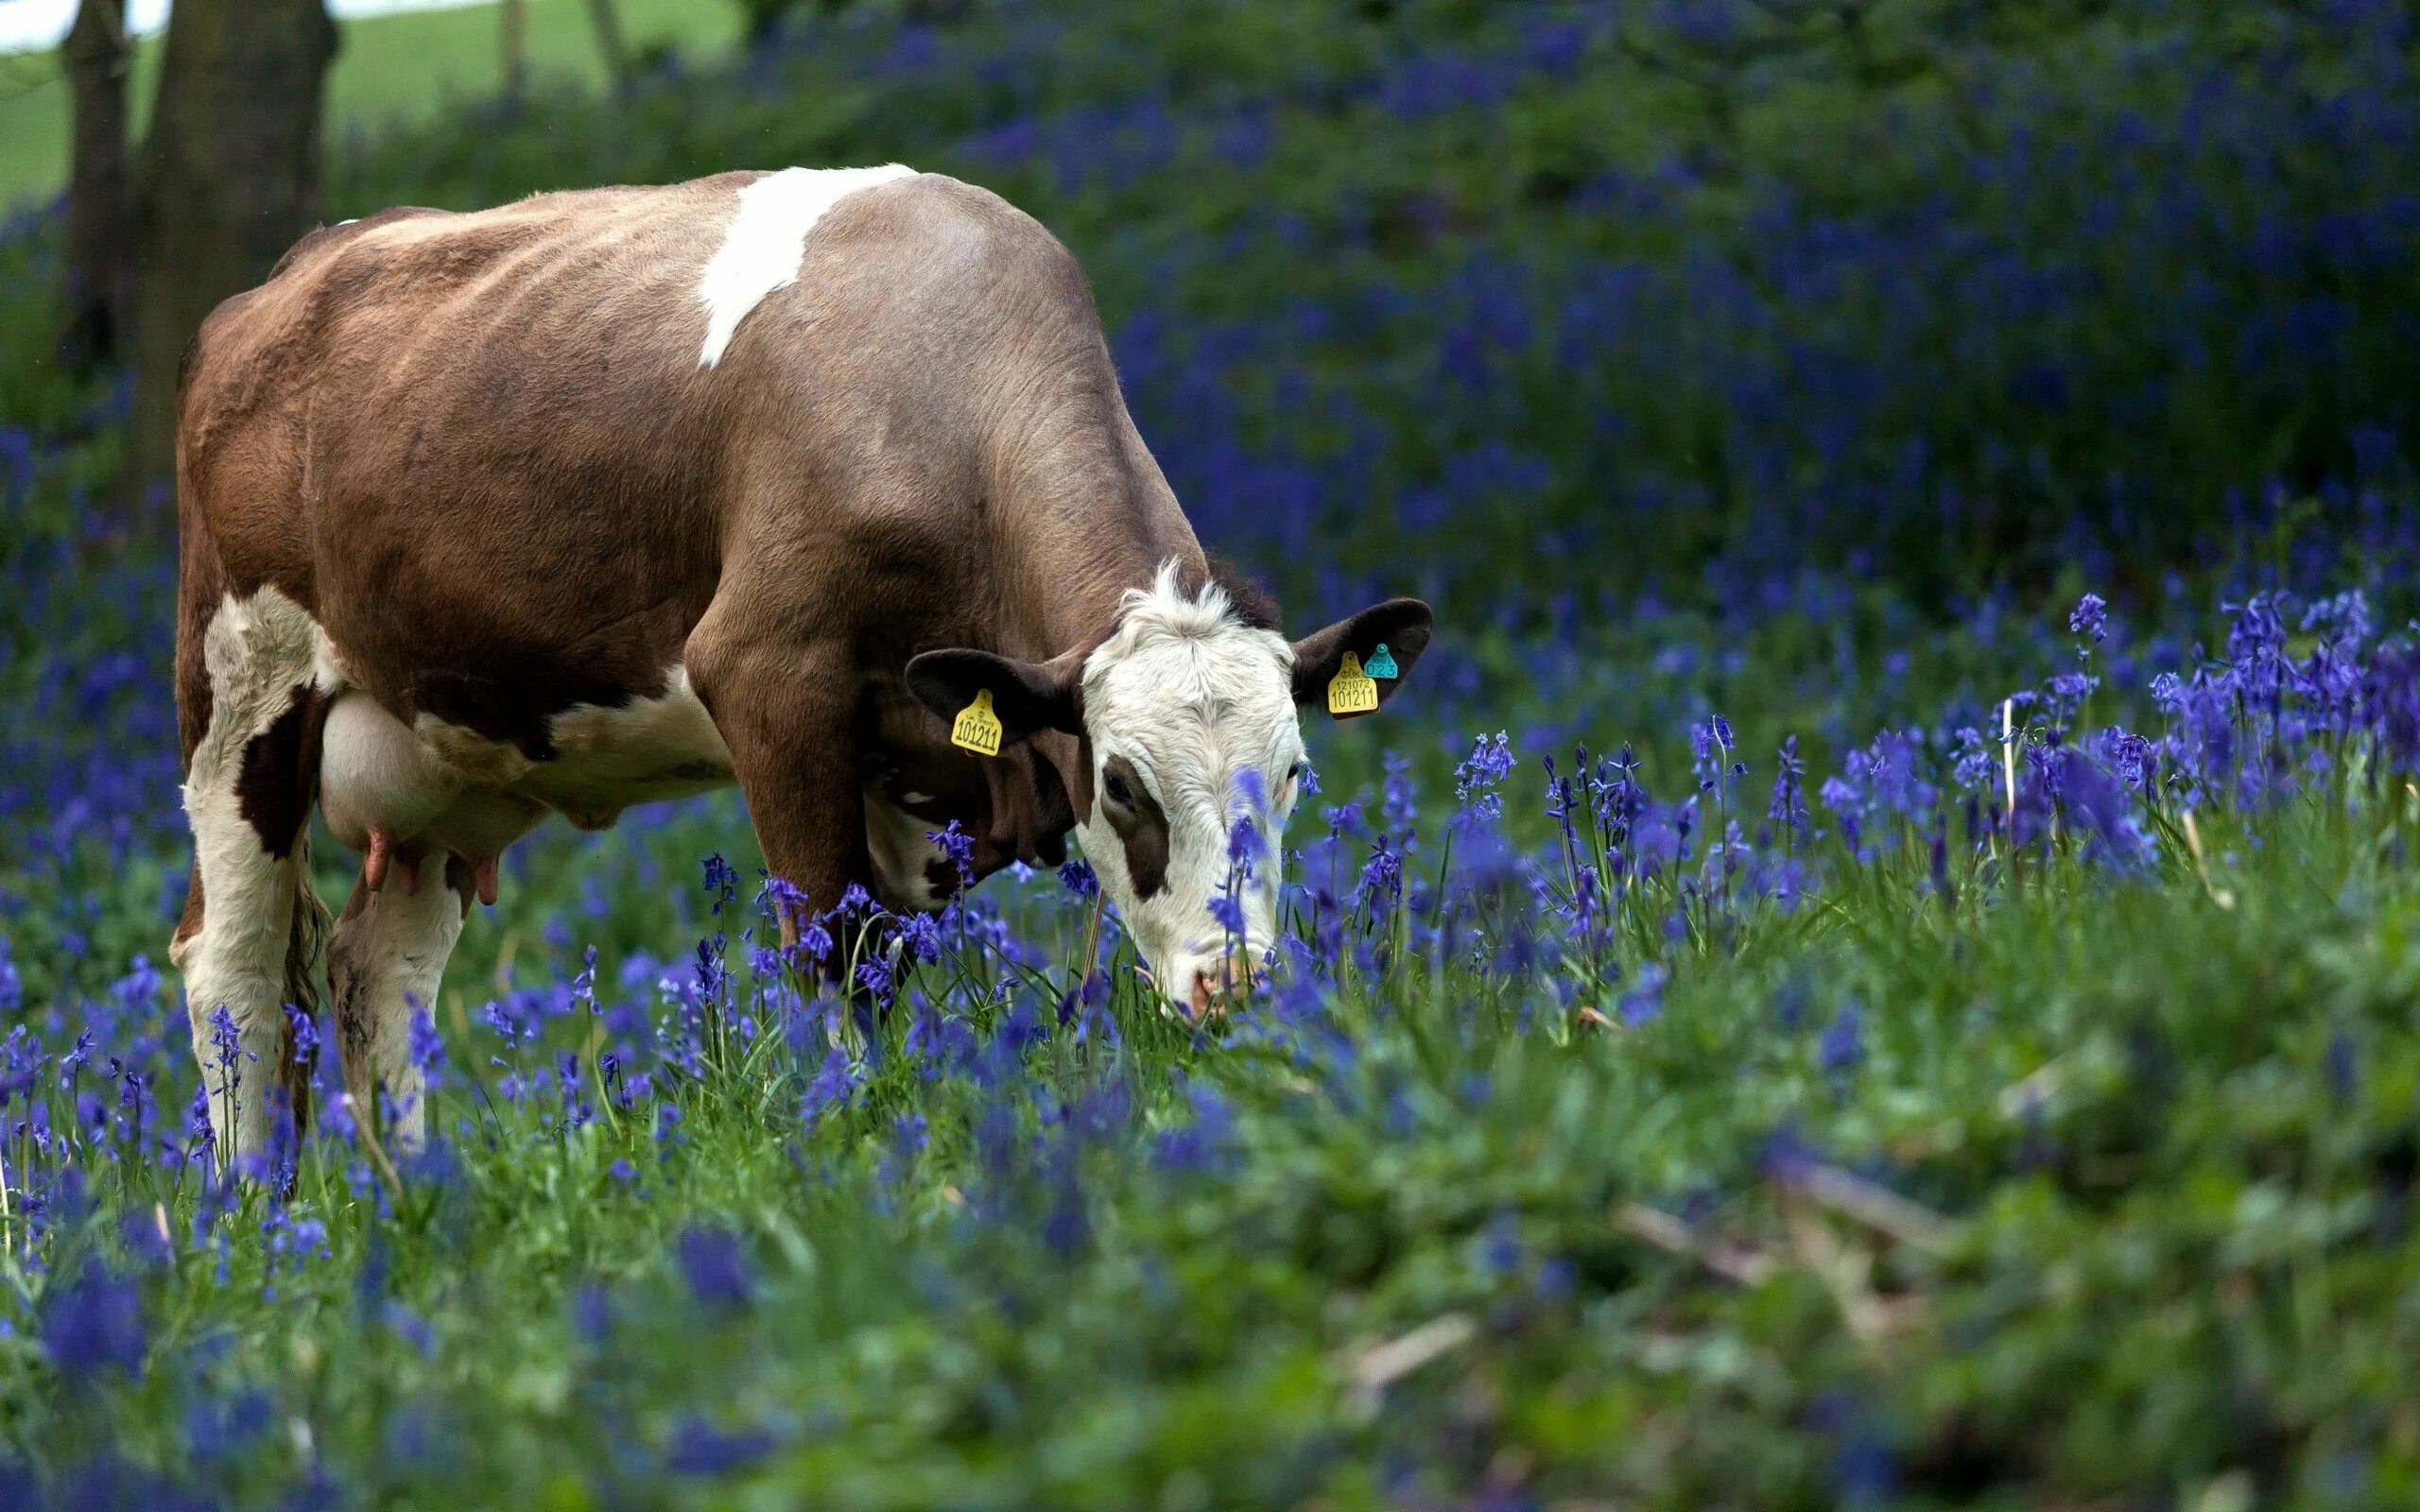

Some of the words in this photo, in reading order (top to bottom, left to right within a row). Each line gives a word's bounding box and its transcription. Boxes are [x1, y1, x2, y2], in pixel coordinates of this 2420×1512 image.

[1367, 664, 1395, 676] 023
[1337, 679, 1370, 690] 121072
[1332, 688, 1374, 708] 101211
[956, 718, 997, 751] 101211
